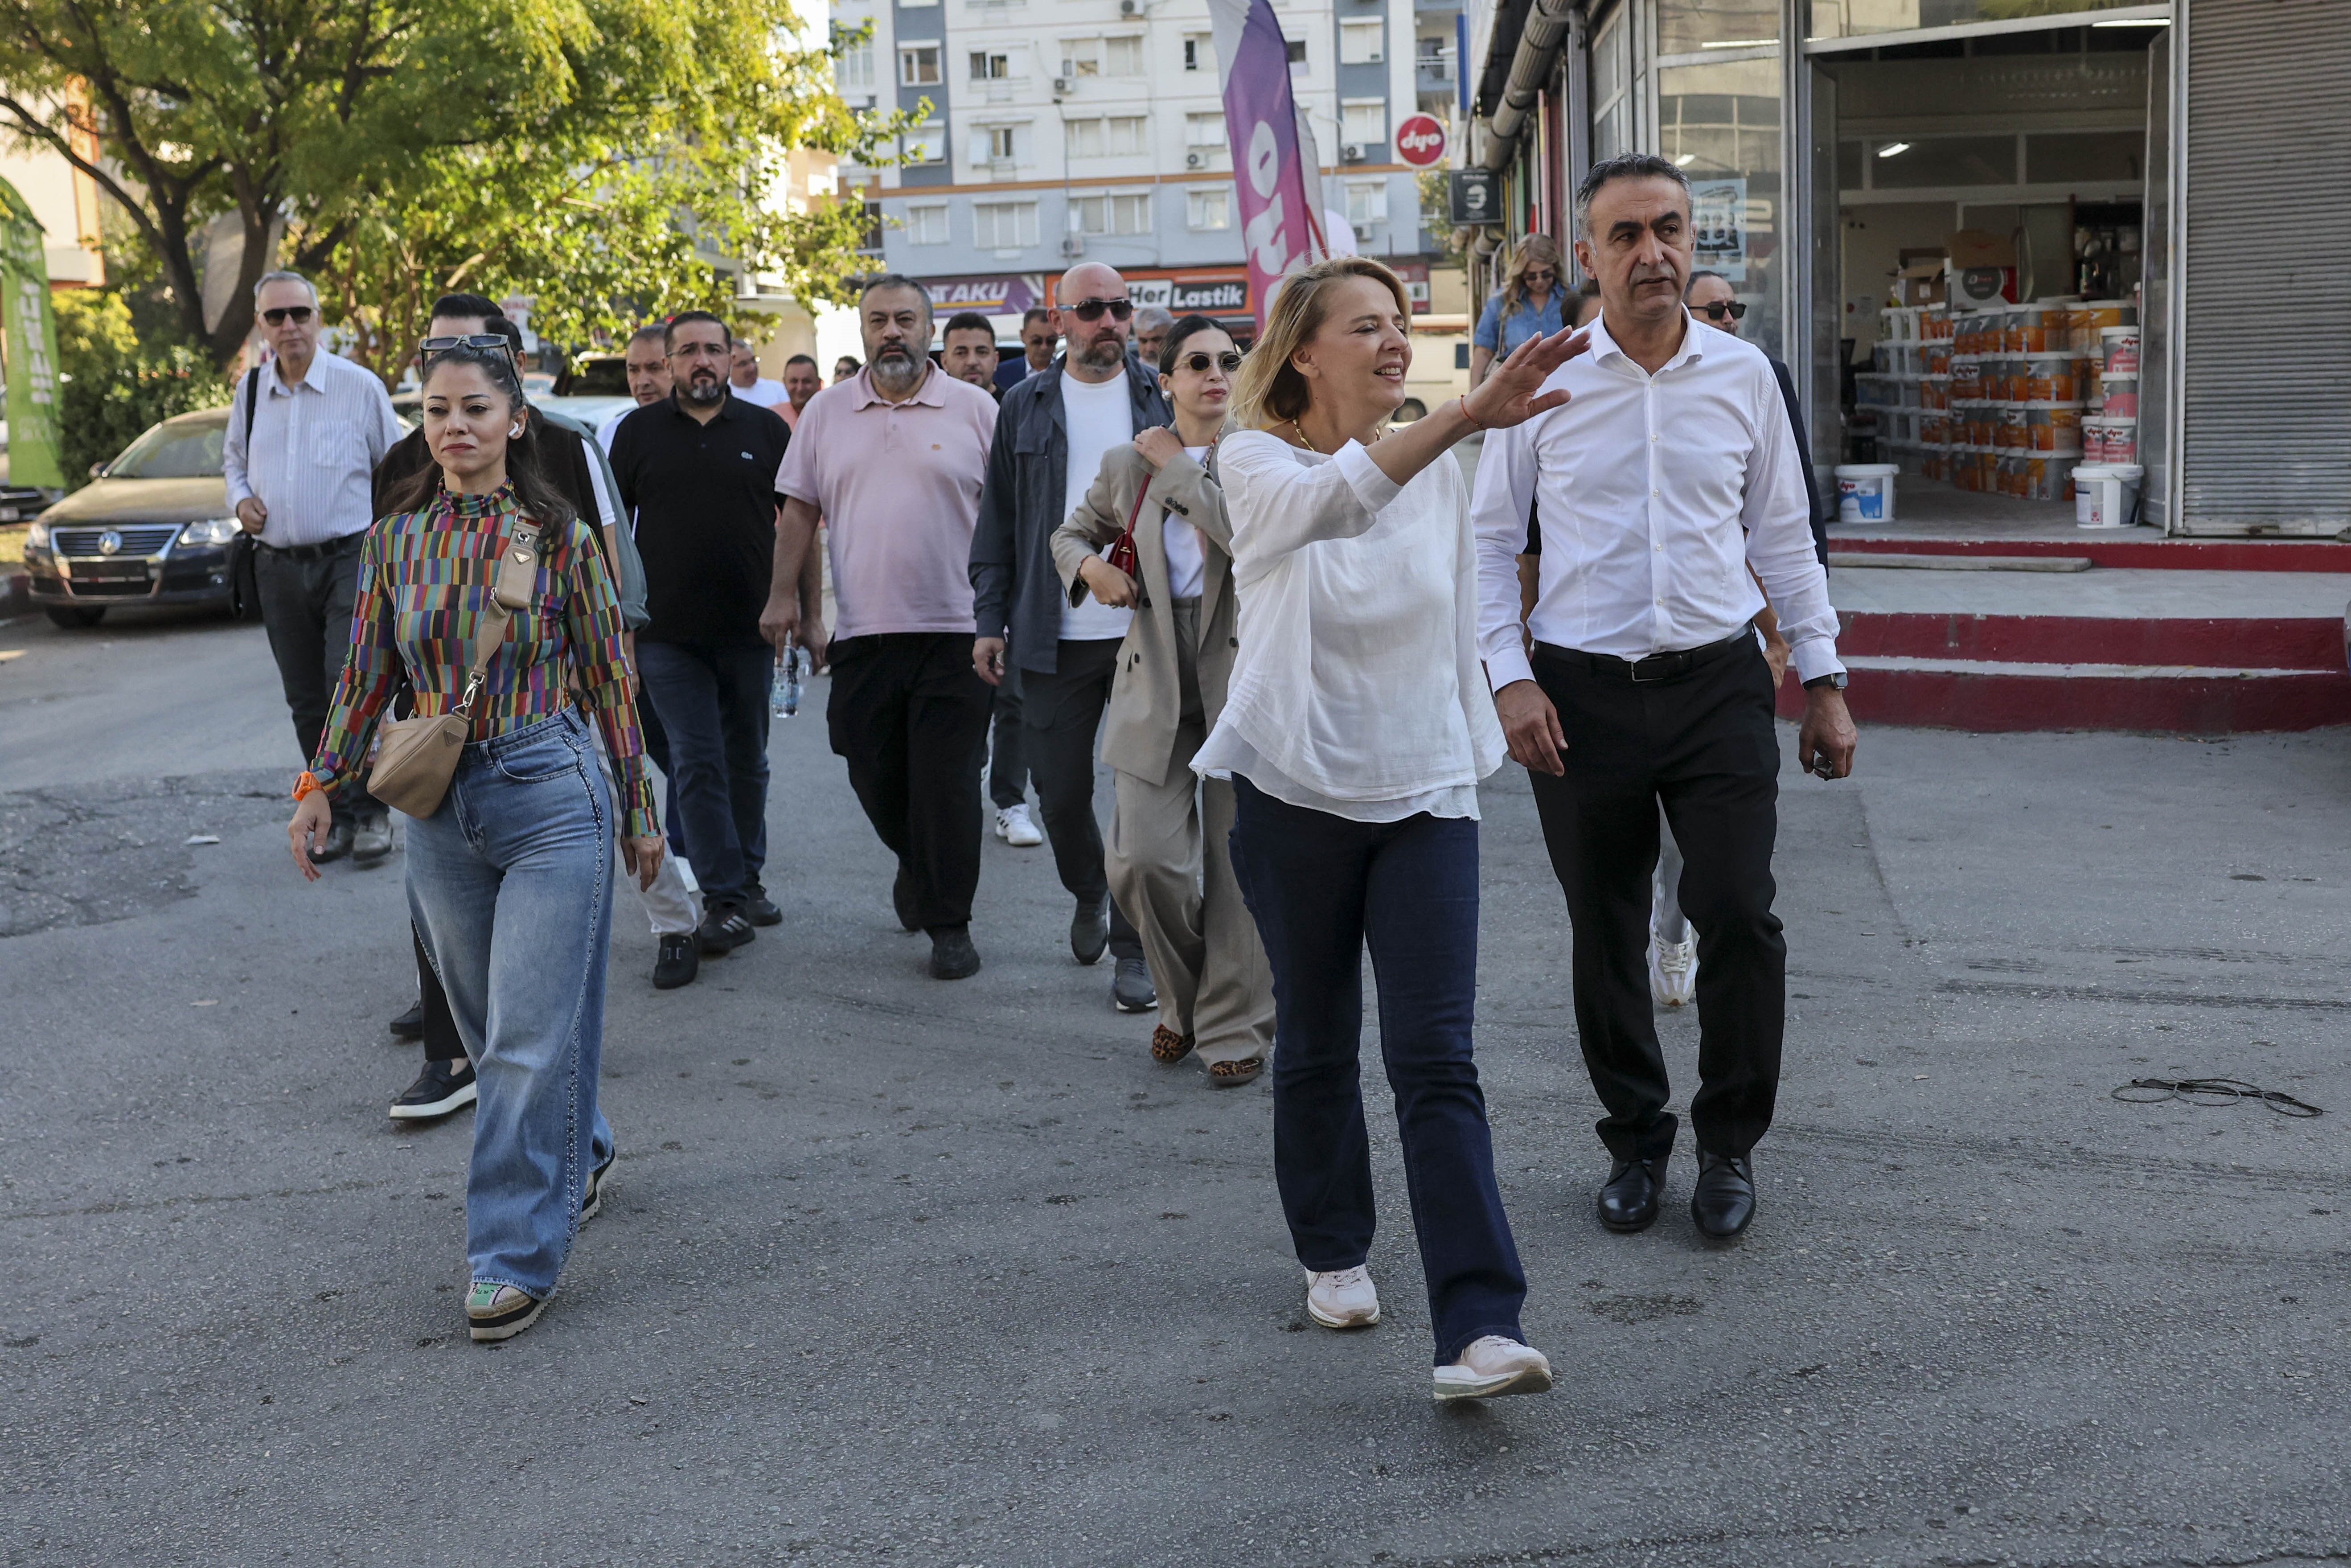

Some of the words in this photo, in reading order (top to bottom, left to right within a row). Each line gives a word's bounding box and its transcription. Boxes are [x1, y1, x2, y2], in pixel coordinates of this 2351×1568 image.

[1401, 130, 1441, 152] dyo
[1173, 285, 1243, 308] Lastik
[2107, 428, 2123, 437] dyo
[1840, 481, 1855, 491] dyo
